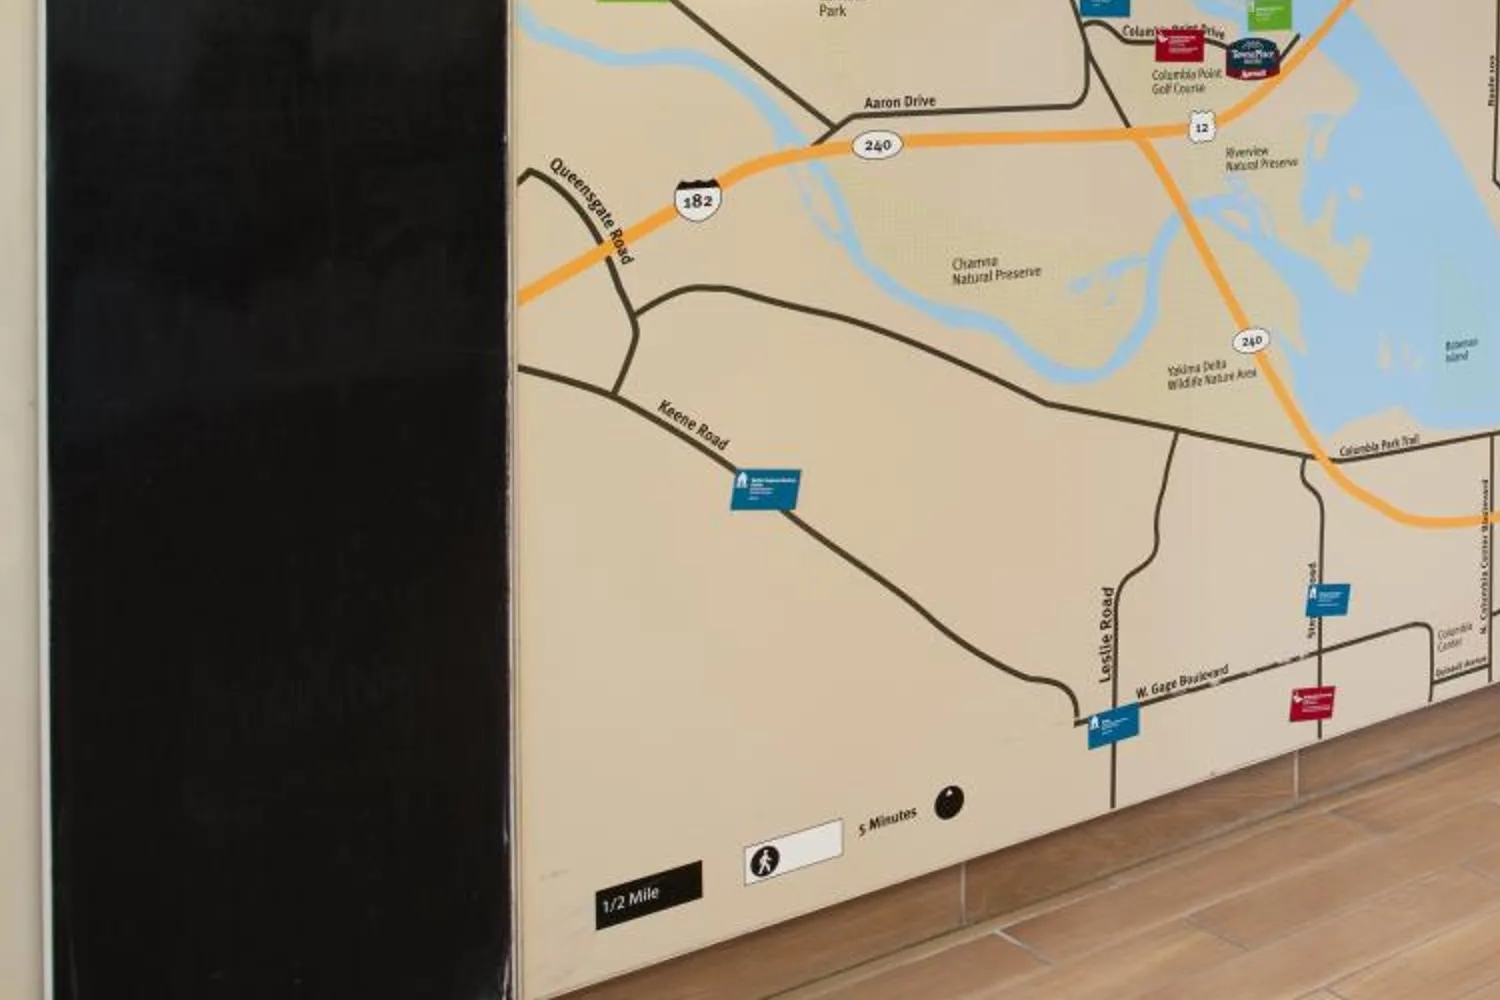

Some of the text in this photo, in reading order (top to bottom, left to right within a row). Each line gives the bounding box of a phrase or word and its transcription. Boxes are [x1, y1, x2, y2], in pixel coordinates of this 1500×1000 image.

[819, 3, 847, 18] Park
[864, 95, 936, 109] Aaron Drive
[1195, 123, 1209, 133] 12
[864, 138, 892, 153] 240
[550, 157, 635, 266] Queensgate Road
[683, 193, 713, 209] 182
[952, 265, 1042, 286] Natural Preserve
[1242, 335, 1264, 349] 240
[657, 399, 731, 452] Keene Road
[1339, 434, 1420, 457] Columbia Park Trail
[1099, 586, 1114, 684] Leslie Road
[1135, 664, 1230, 700] W. Gage Boulevard
[858, 806, 918, 837] 5 Minutes
[602, 885, 660, 914] 1/2 Mile
